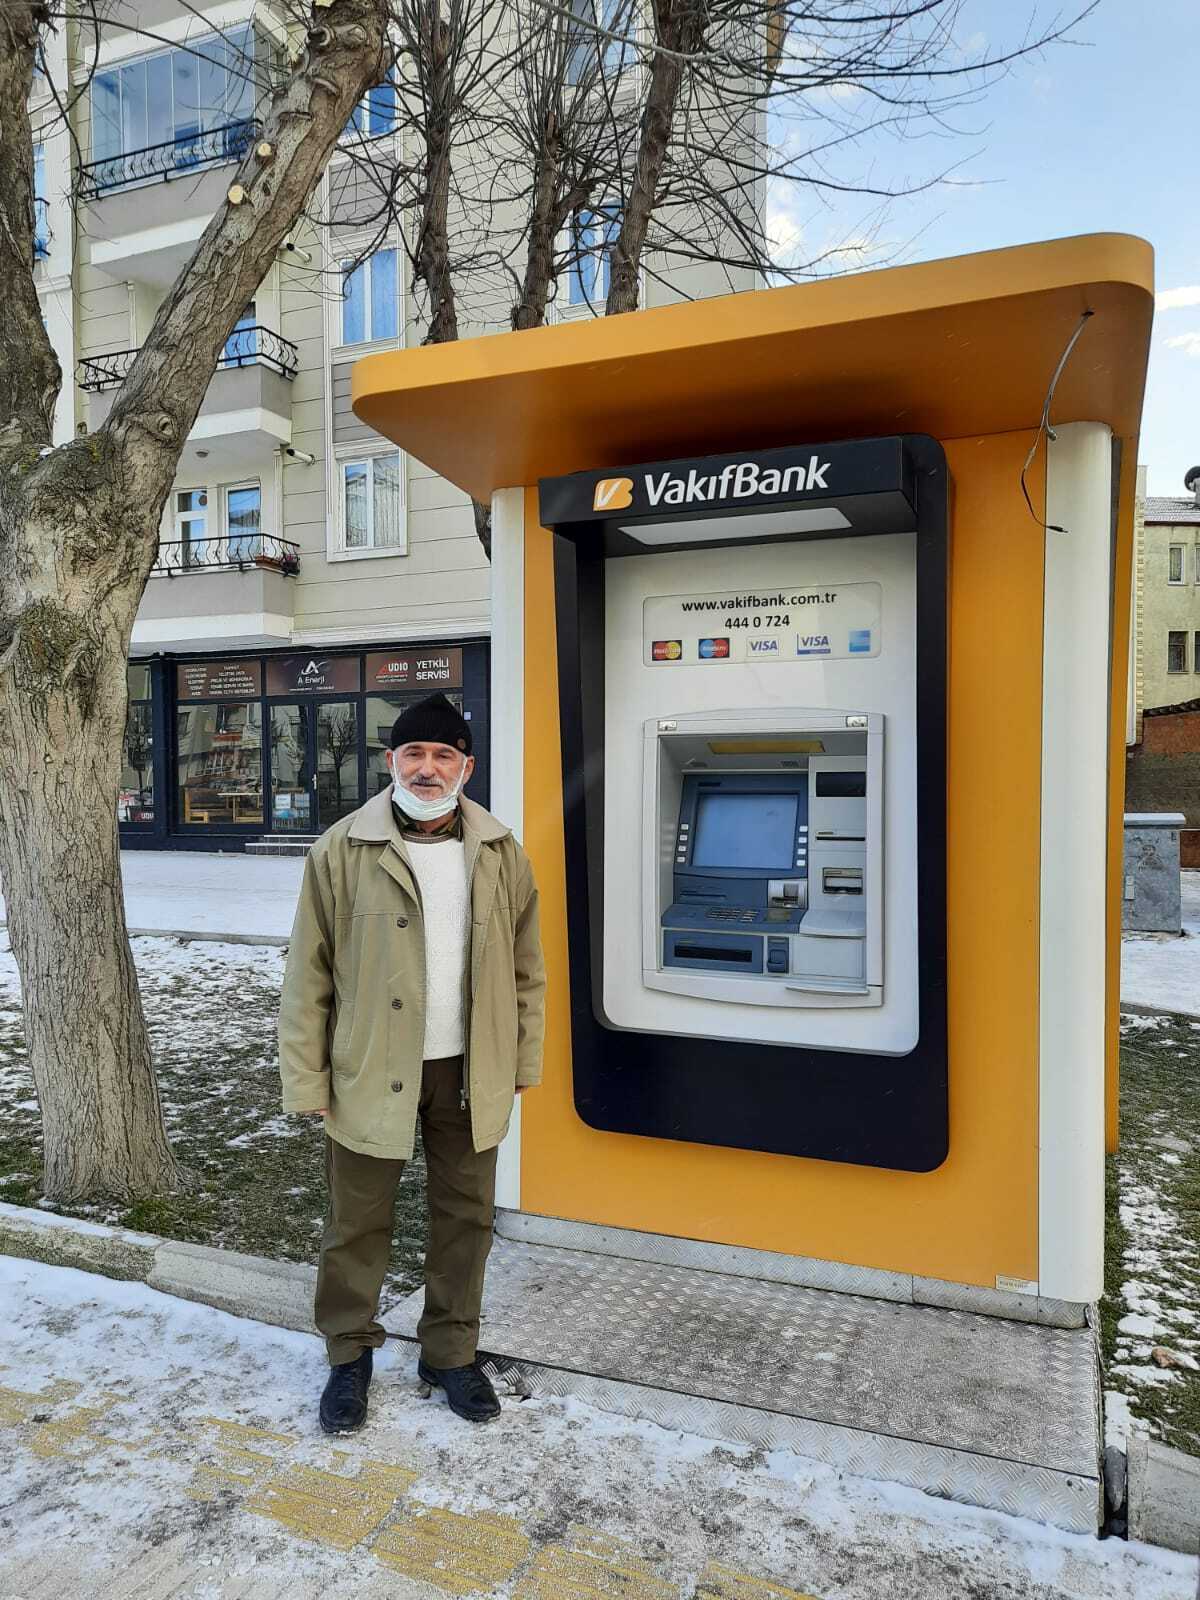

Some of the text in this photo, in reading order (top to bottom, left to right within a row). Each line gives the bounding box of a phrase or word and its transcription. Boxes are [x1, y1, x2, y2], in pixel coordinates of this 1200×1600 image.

[682, 592, 837, 612] www.vakifbank.com.tr
[724, 615, 790, 629] 444 0 724
[751, 640, 778, 651] VISA
[802, 636, 829, 647] VISA
[416, 657, 449, 669] YETKİLİ
[416, 669, 450, 680] SERVİSİ
